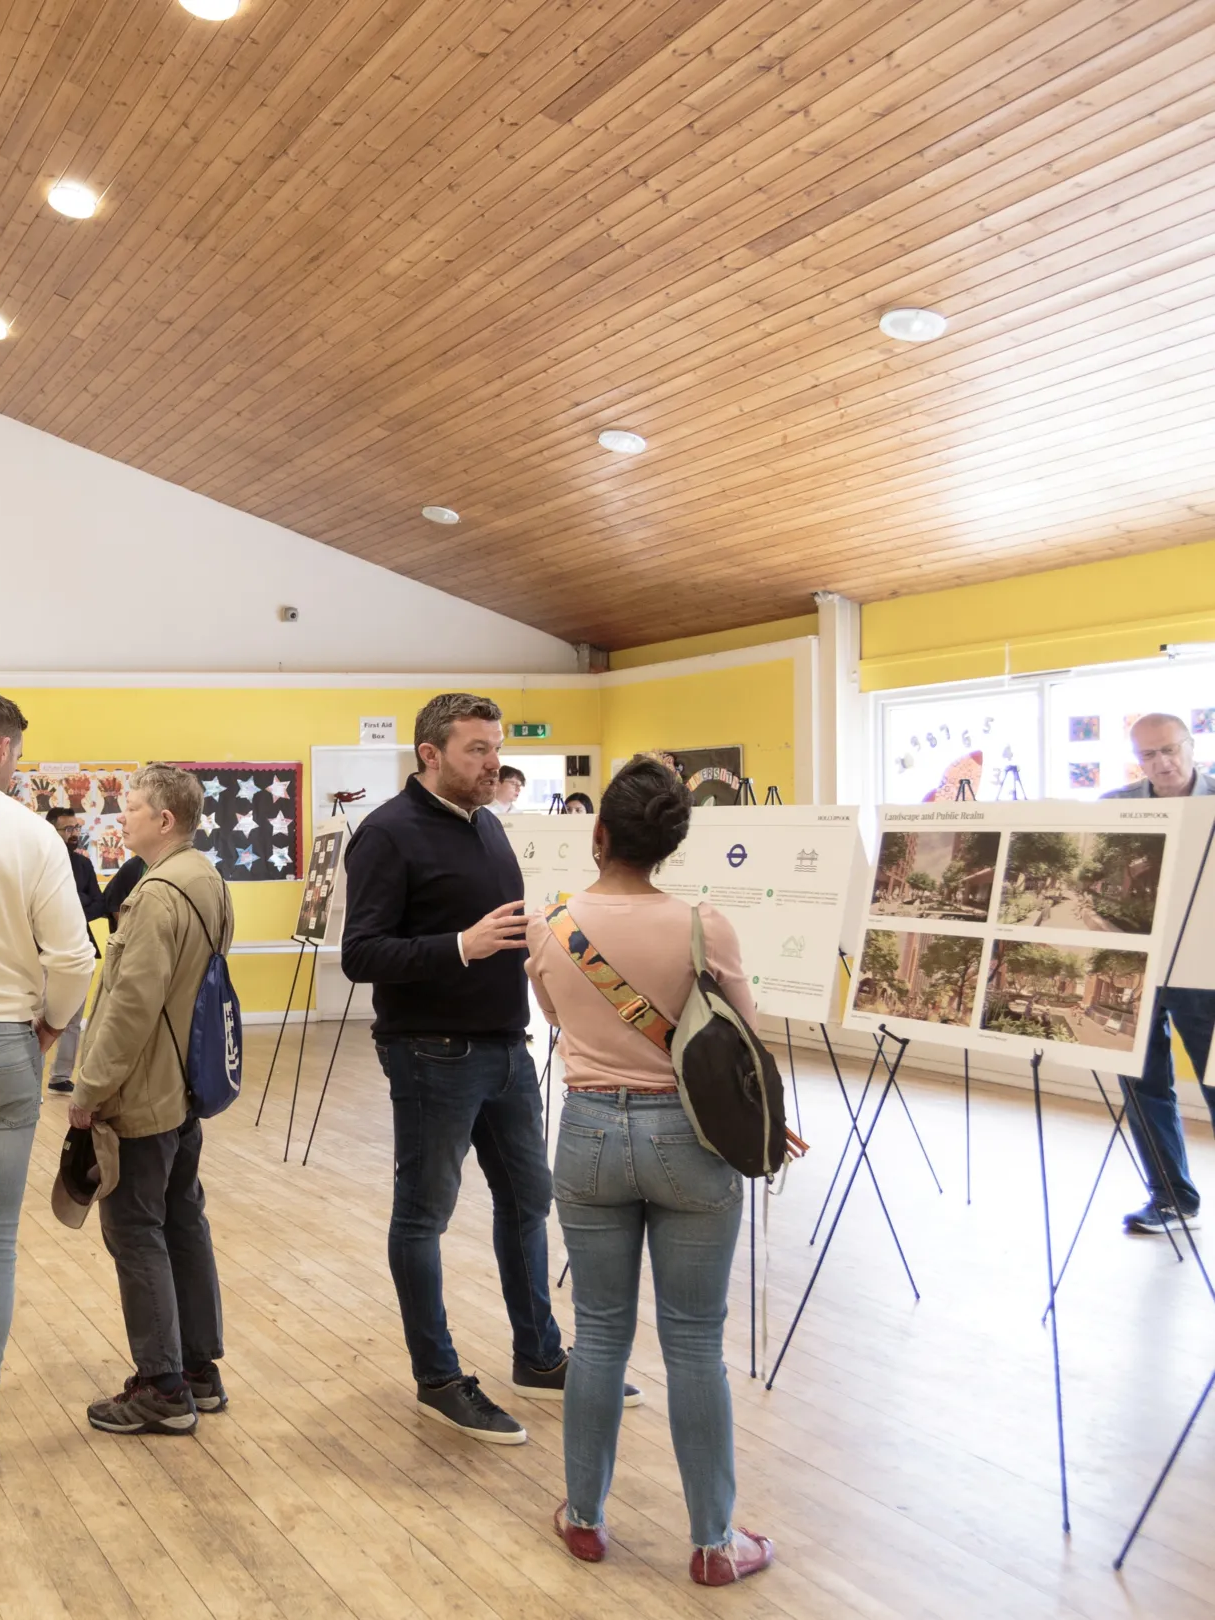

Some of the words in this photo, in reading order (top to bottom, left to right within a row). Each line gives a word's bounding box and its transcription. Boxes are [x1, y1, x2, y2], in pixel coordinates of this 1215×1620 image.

[982, 716, 995, 734] 5
[884, 812, 920, 822] Landscape
[920, 812, 935, 820] and
[936, 811, 960, 820] Public
[960, 811, 985, 820] Realm
